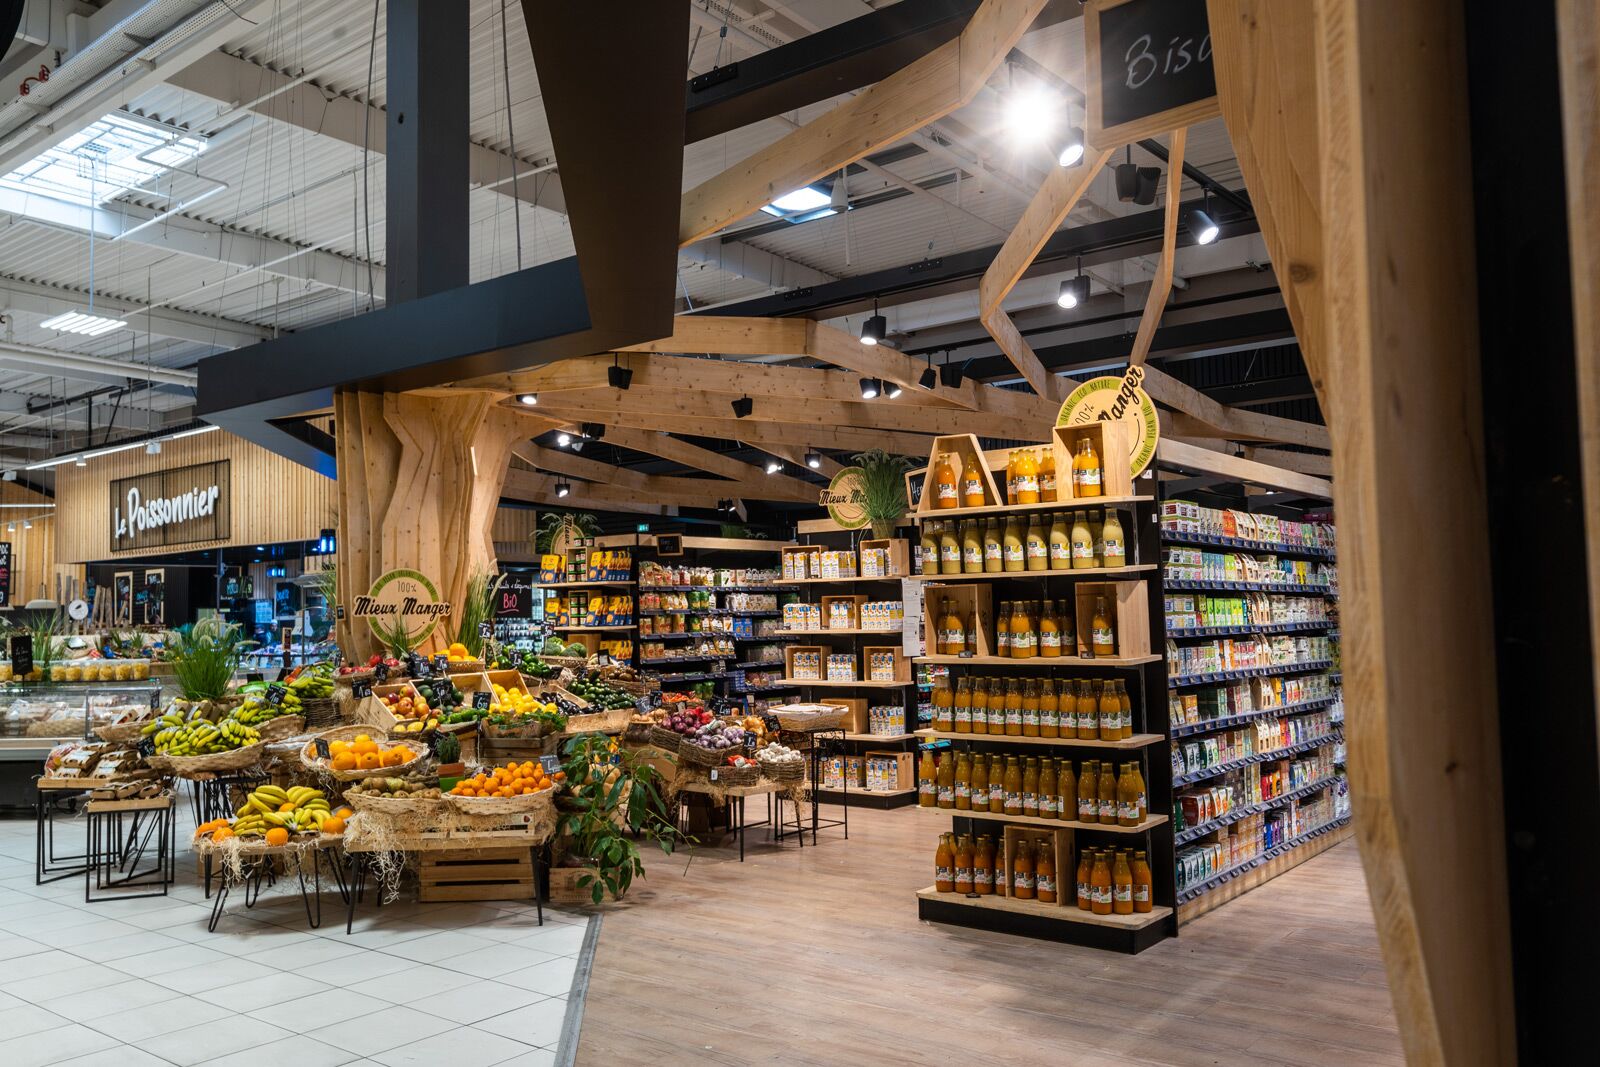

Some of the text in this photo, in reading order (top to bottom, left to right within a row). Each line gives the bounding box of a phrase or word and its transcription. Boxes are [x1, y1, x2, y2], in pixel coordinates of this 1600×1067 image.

[819, 490, 848, 504] Mieux
[114, 485, 219, 539] Le Poissonnier
[397, 580, 417, 593] 100%
[354, 596, 451, 621] Mieux Manger
